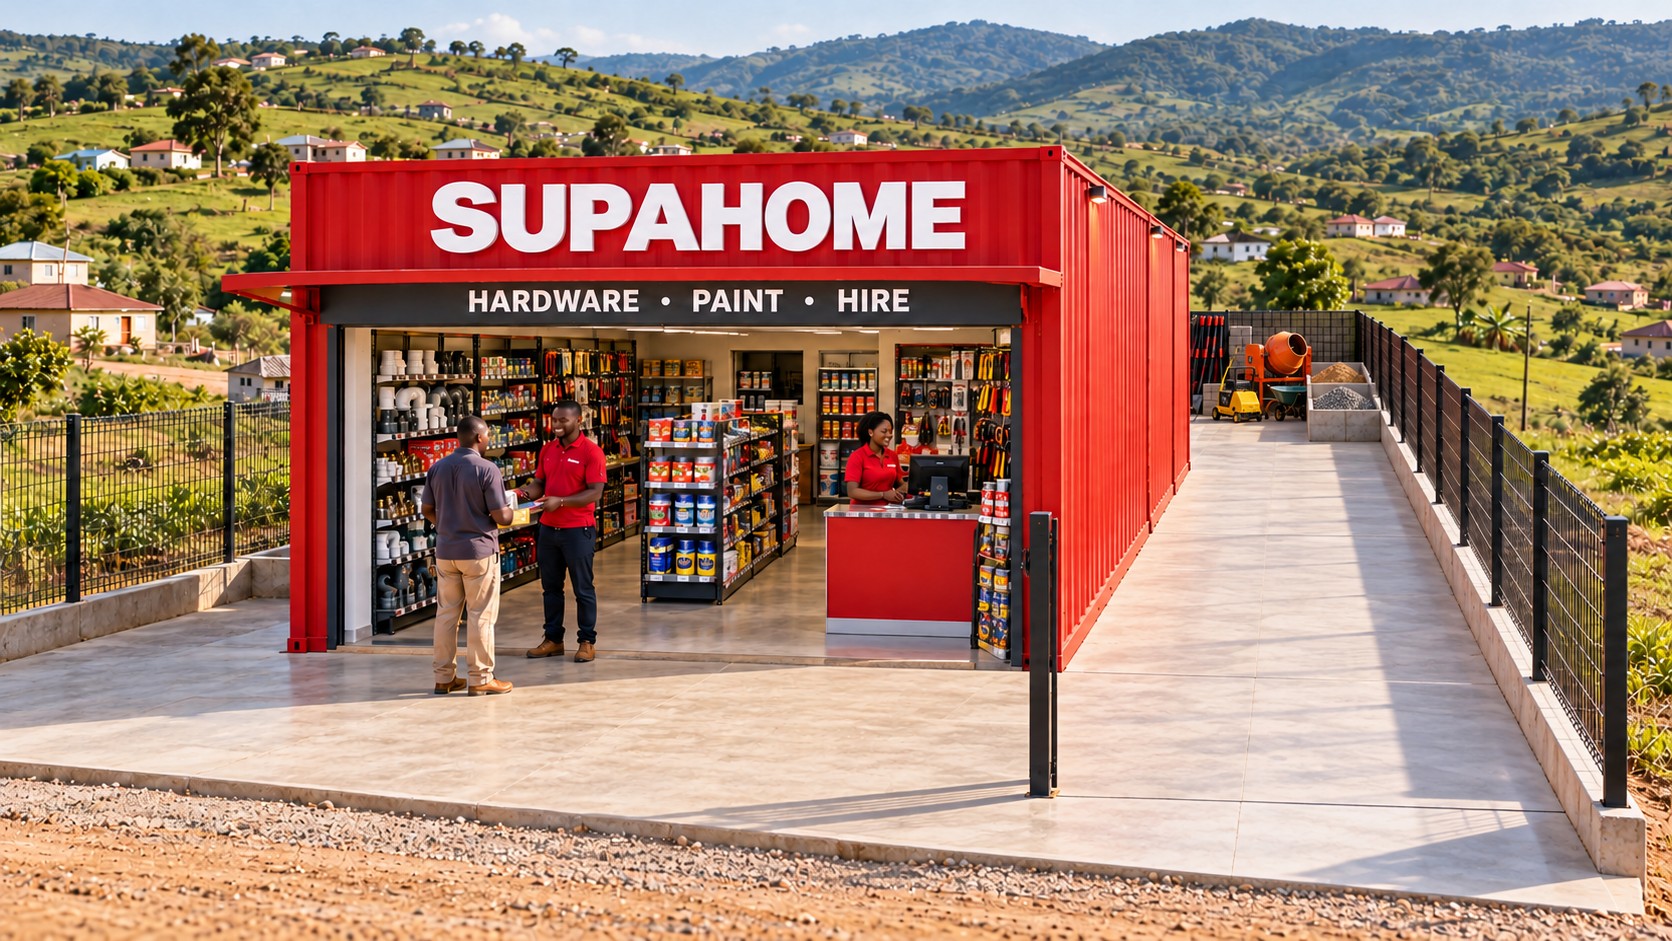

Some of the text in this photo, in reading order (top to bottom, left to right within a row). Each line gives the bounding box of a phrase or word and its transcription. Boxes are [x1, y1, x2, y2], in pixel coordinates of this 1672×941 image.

[430, 181, 966, 254] SUPAHOME
[468, 289, 910, 313] HARDWARE PAINT HIRE
